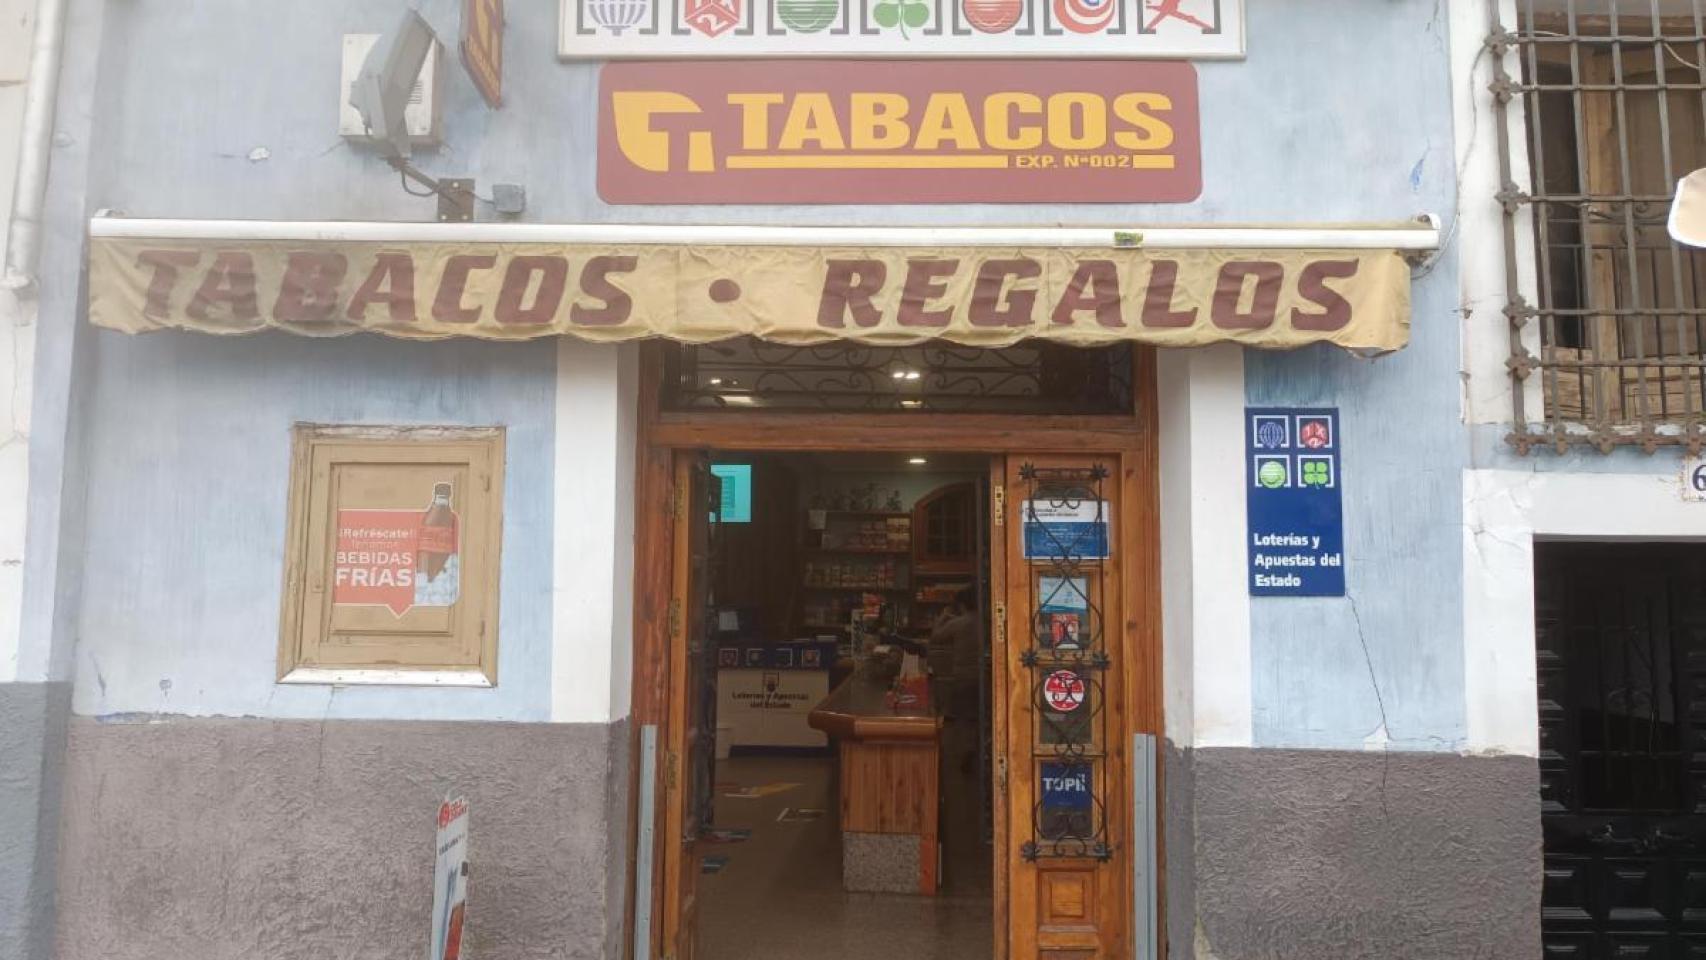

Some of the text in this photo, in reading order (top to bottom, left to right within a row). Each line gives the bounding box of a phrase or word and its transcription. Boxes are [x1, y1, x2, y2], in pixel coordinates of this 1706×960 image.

[726, 93, 1175, 151] TABACOS
[1015, 154, 1058, 169] EXP.
[136, 249, 1360, 332] TABACOS REGALOS
[1253, 532, 1320, 550] Loterías y
[336, 551, 413, 566] BEBIDAS
[1254, 552, 1341, 570] Apuestas del
[1254, 573, 1302, 587] Estado
